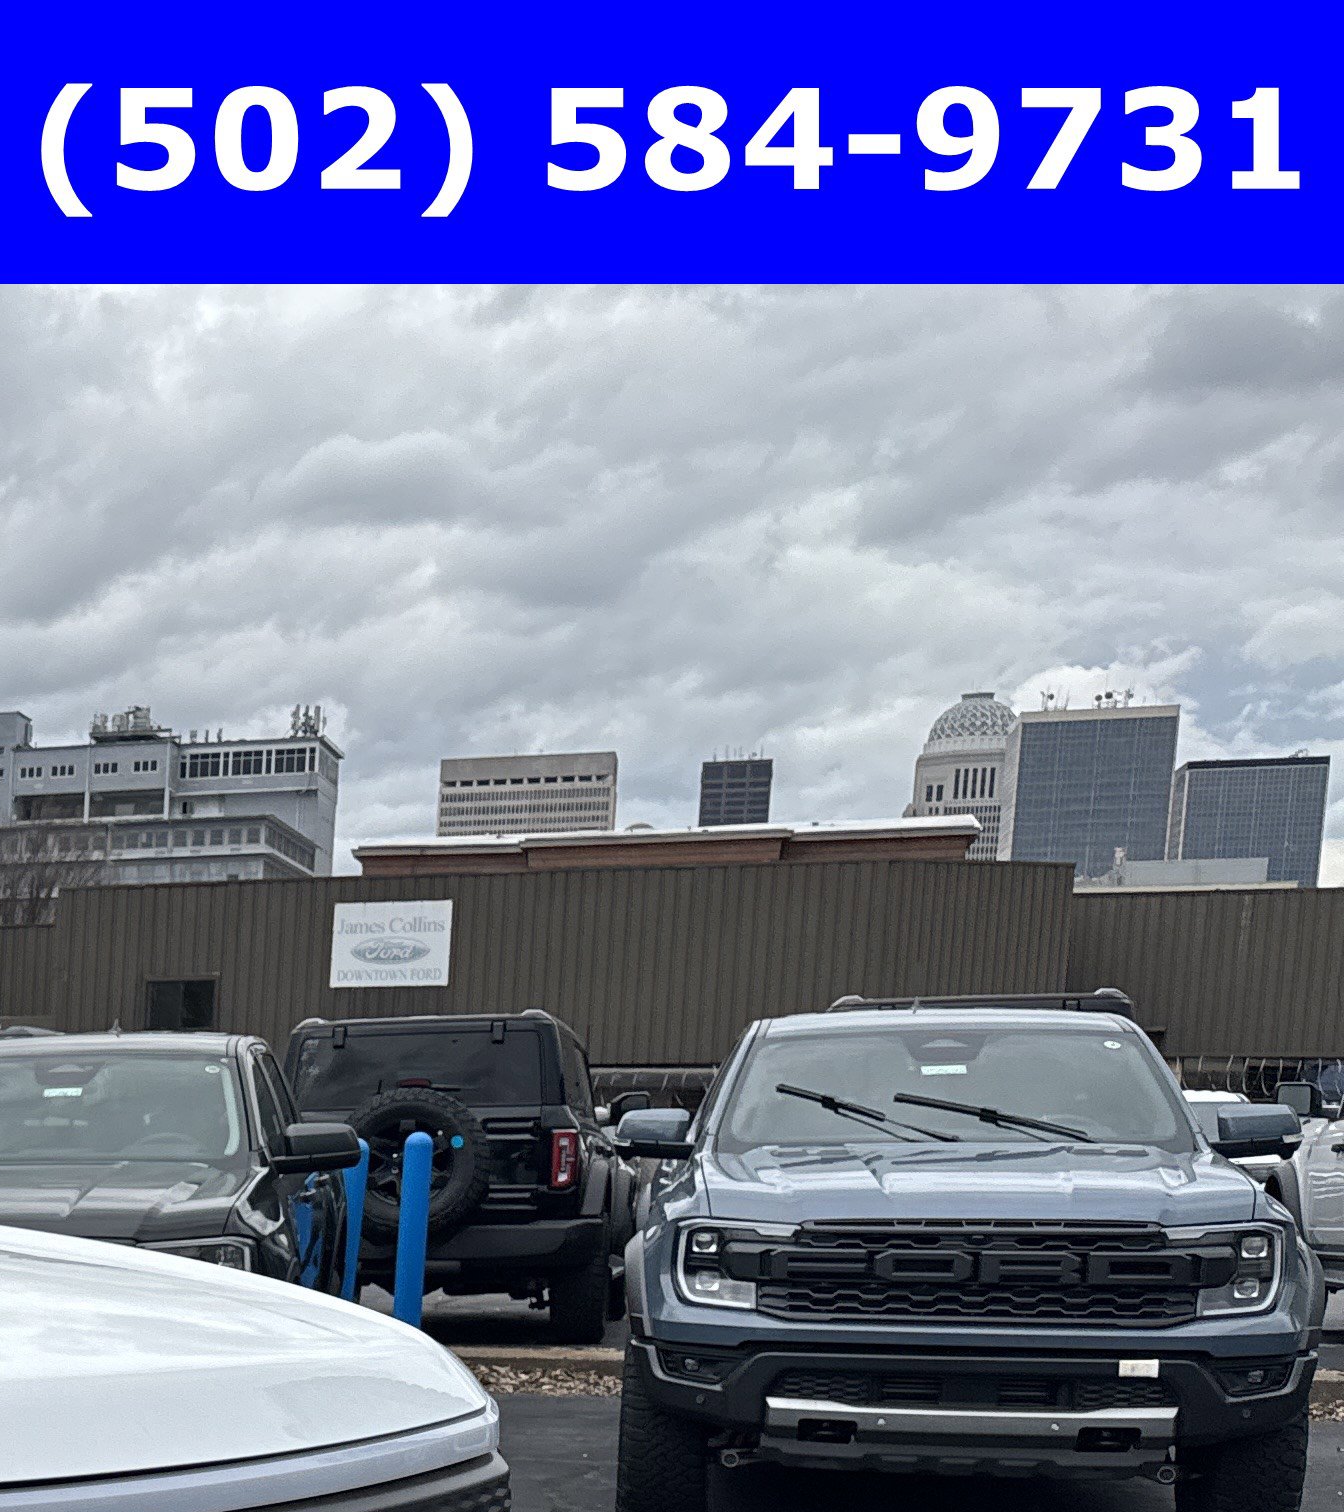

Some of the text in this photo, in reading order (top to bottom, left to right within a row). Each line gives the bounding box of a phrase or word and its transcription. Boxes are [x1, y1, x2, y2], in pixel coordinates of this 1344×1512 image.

[337, 916, 446, 935] James Collins
[365, 940, 414, 959] Ford
[337, 968, 443, 982] DOWNTOWN FORD
[771, 1247, 1196, 1286] FORD
